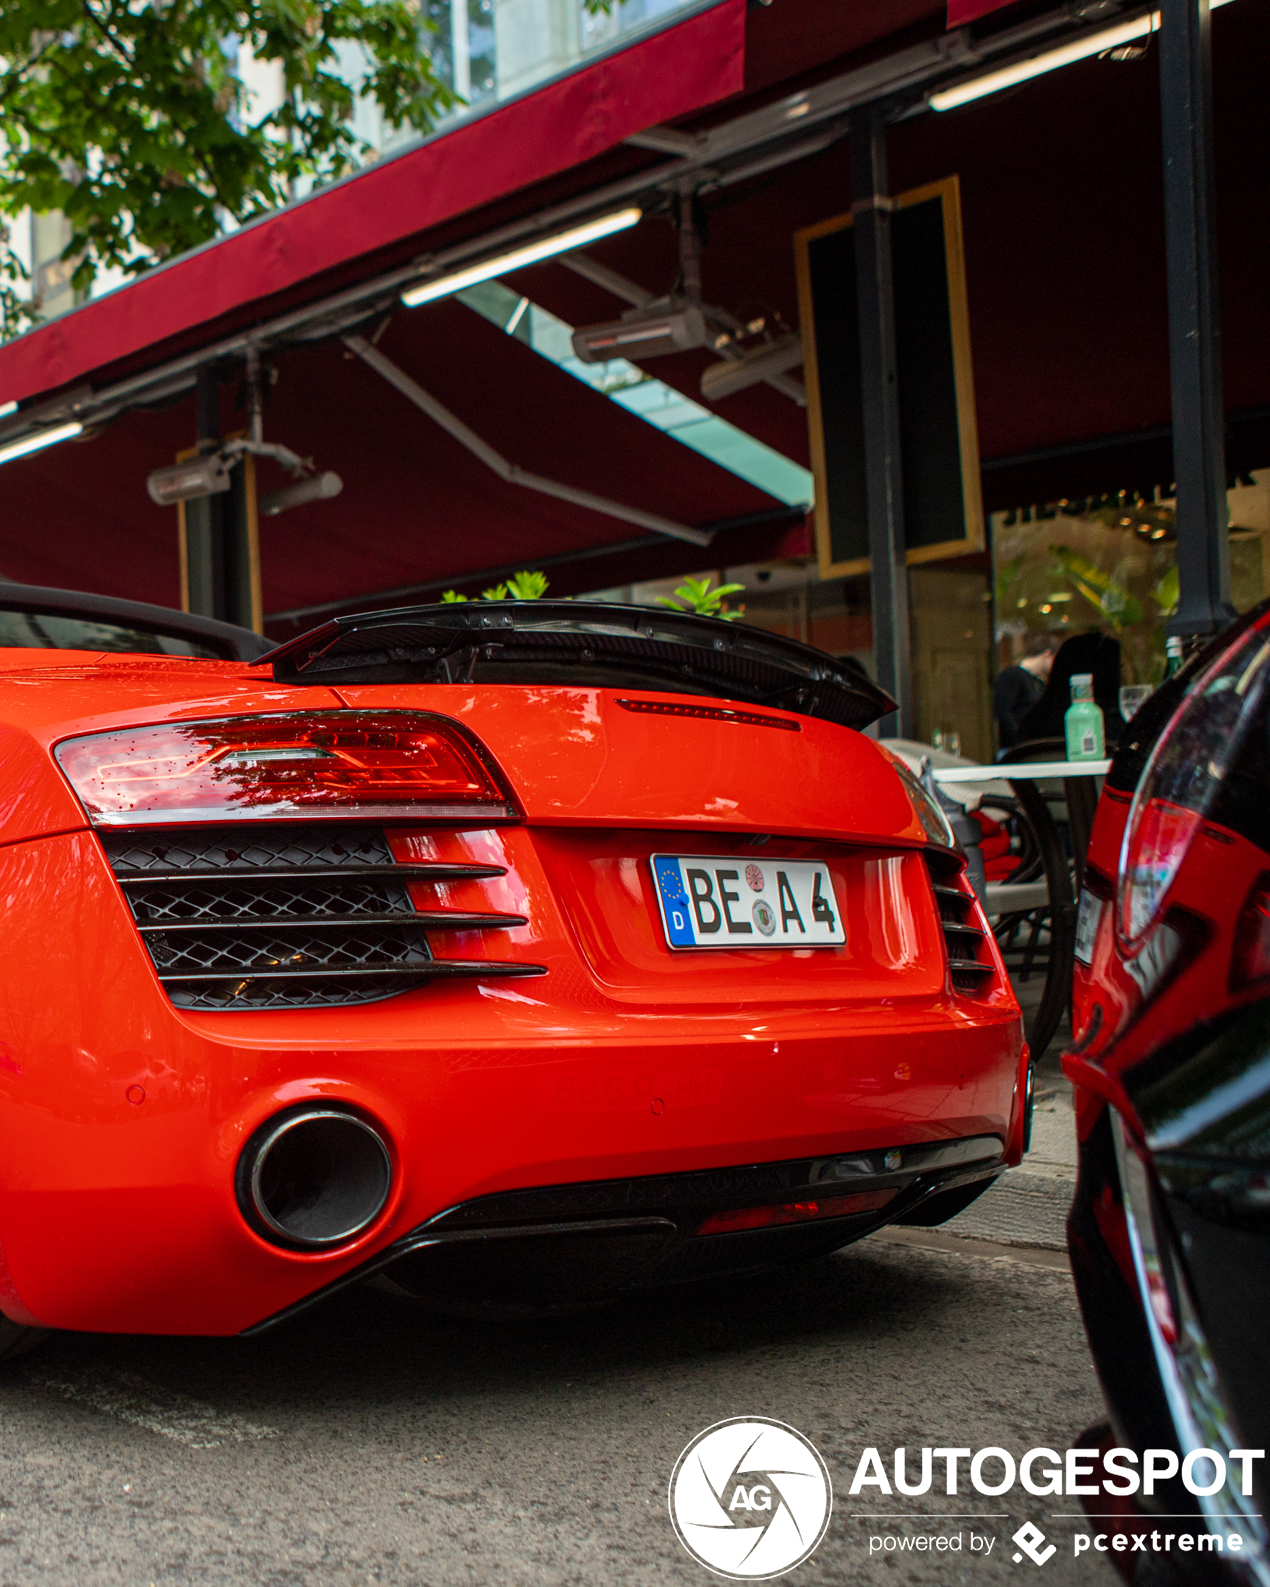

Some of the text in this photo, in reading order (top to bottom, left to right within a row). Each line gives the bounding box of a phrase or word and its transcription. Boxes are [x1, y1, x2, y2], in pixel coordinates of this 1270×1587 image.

[672, 911, 684, 930] D
[685, 868, 836, 934] BE A 4
